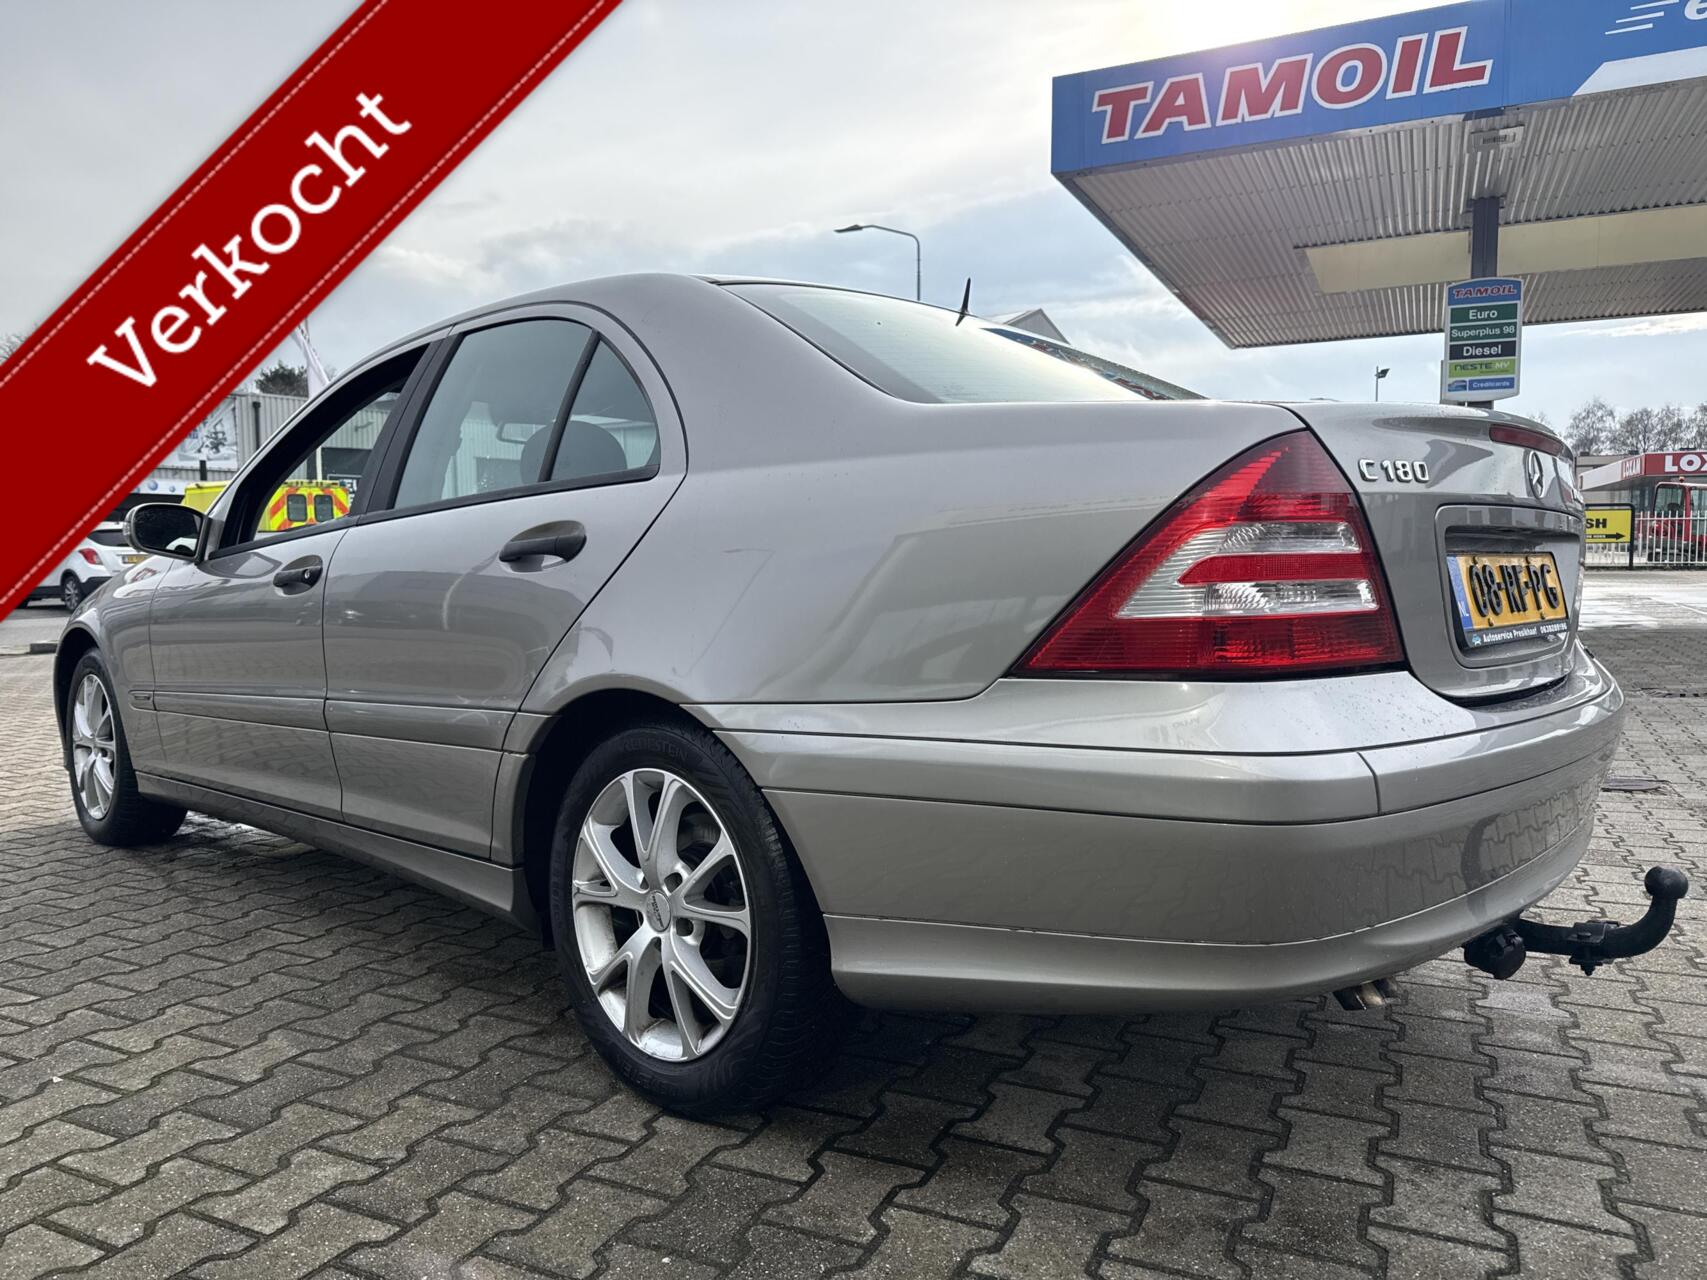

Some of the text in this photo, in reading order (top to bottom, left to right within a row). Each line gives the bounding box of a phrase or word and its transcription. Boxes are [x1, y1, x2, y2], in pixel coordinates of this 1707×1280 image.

[1092, 26, 1493, 145] TAMOIL
[1454, 285, 1517, 298] TAMOIL
[1469, 309, 1498, 320] Euro
[1451, 325, 1515, 338] Superplus 98
[1463, 345, 1502, 356] Diesel
[1664, 454, 1707, 472] LO
[1358, 458, 1429, 483] C 180
